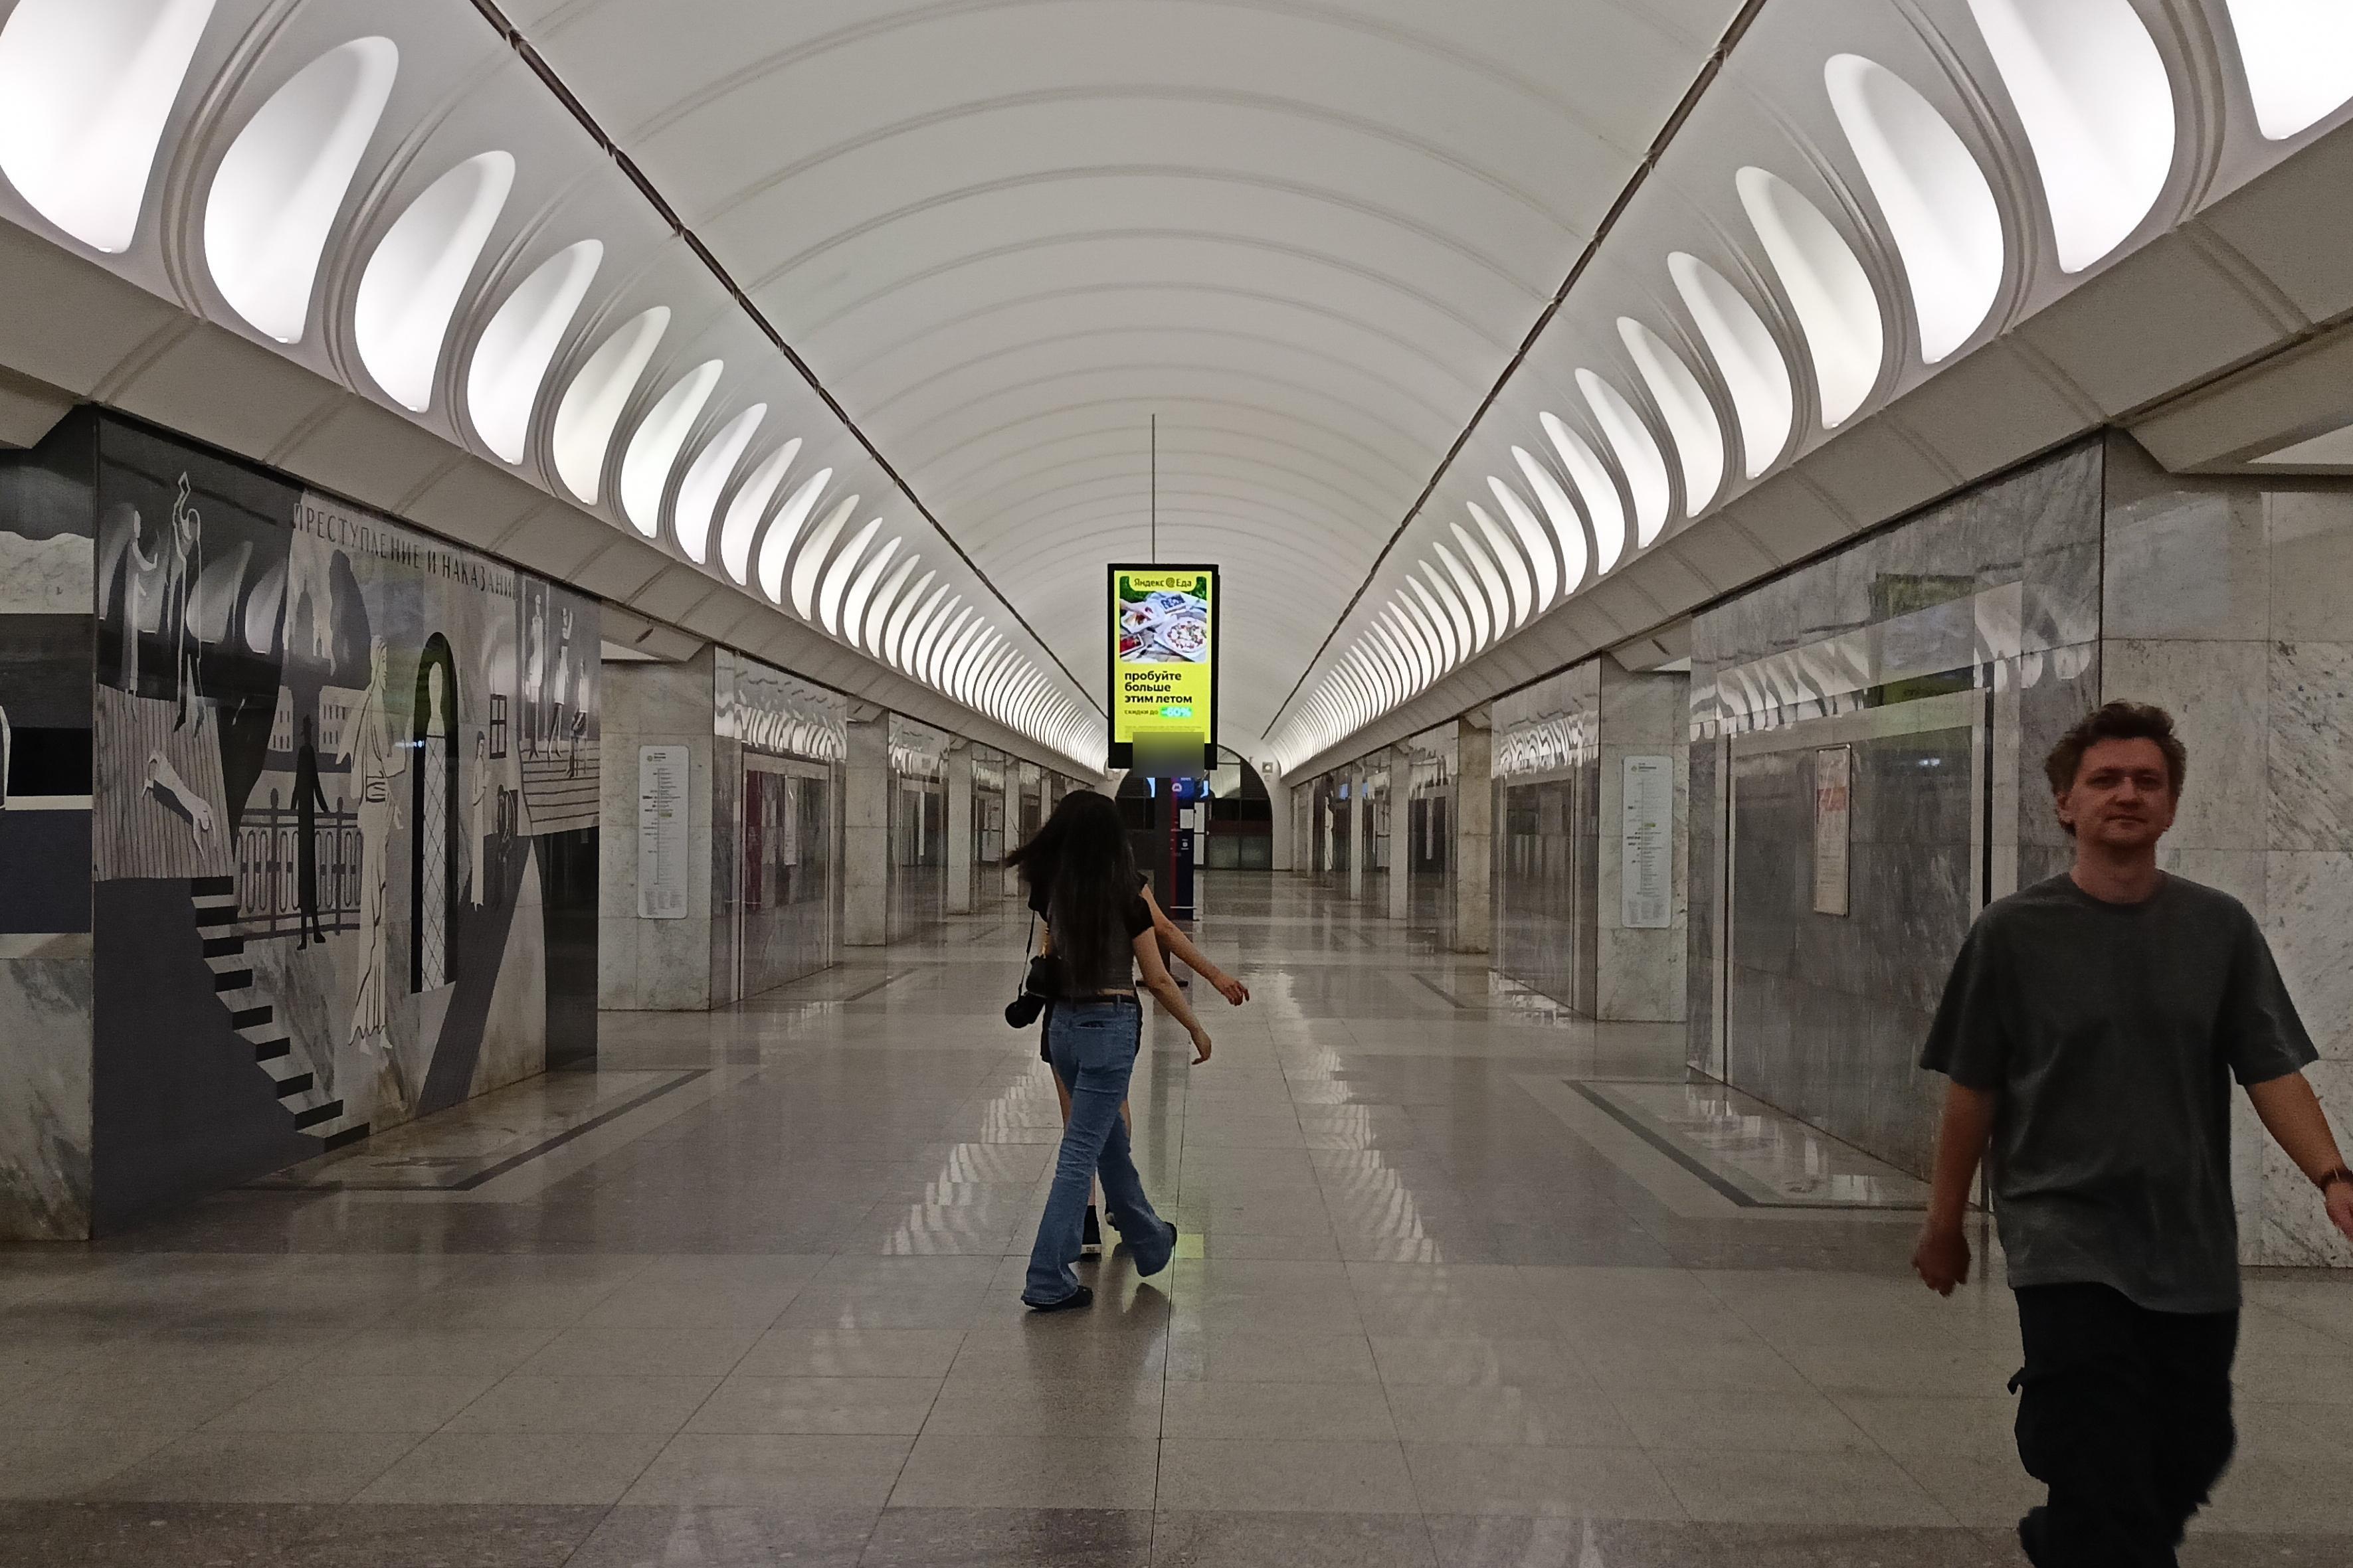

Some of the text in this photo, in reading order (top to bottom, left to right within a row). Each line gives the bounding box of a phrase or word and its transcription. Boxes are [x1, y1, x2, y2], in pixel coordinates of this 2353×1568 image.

[292, 503, 419, 568] ПРЕСТУПЛЕНИЕ
[427, 550, 436, 574] И
[1134, 578, 1192, 588] Яндекс Еда
[1124, 670, 1182, 683] пробуйте
[1124, 681, 1171, 692] больше
[1124, 695, 1192, 703] этим летом
